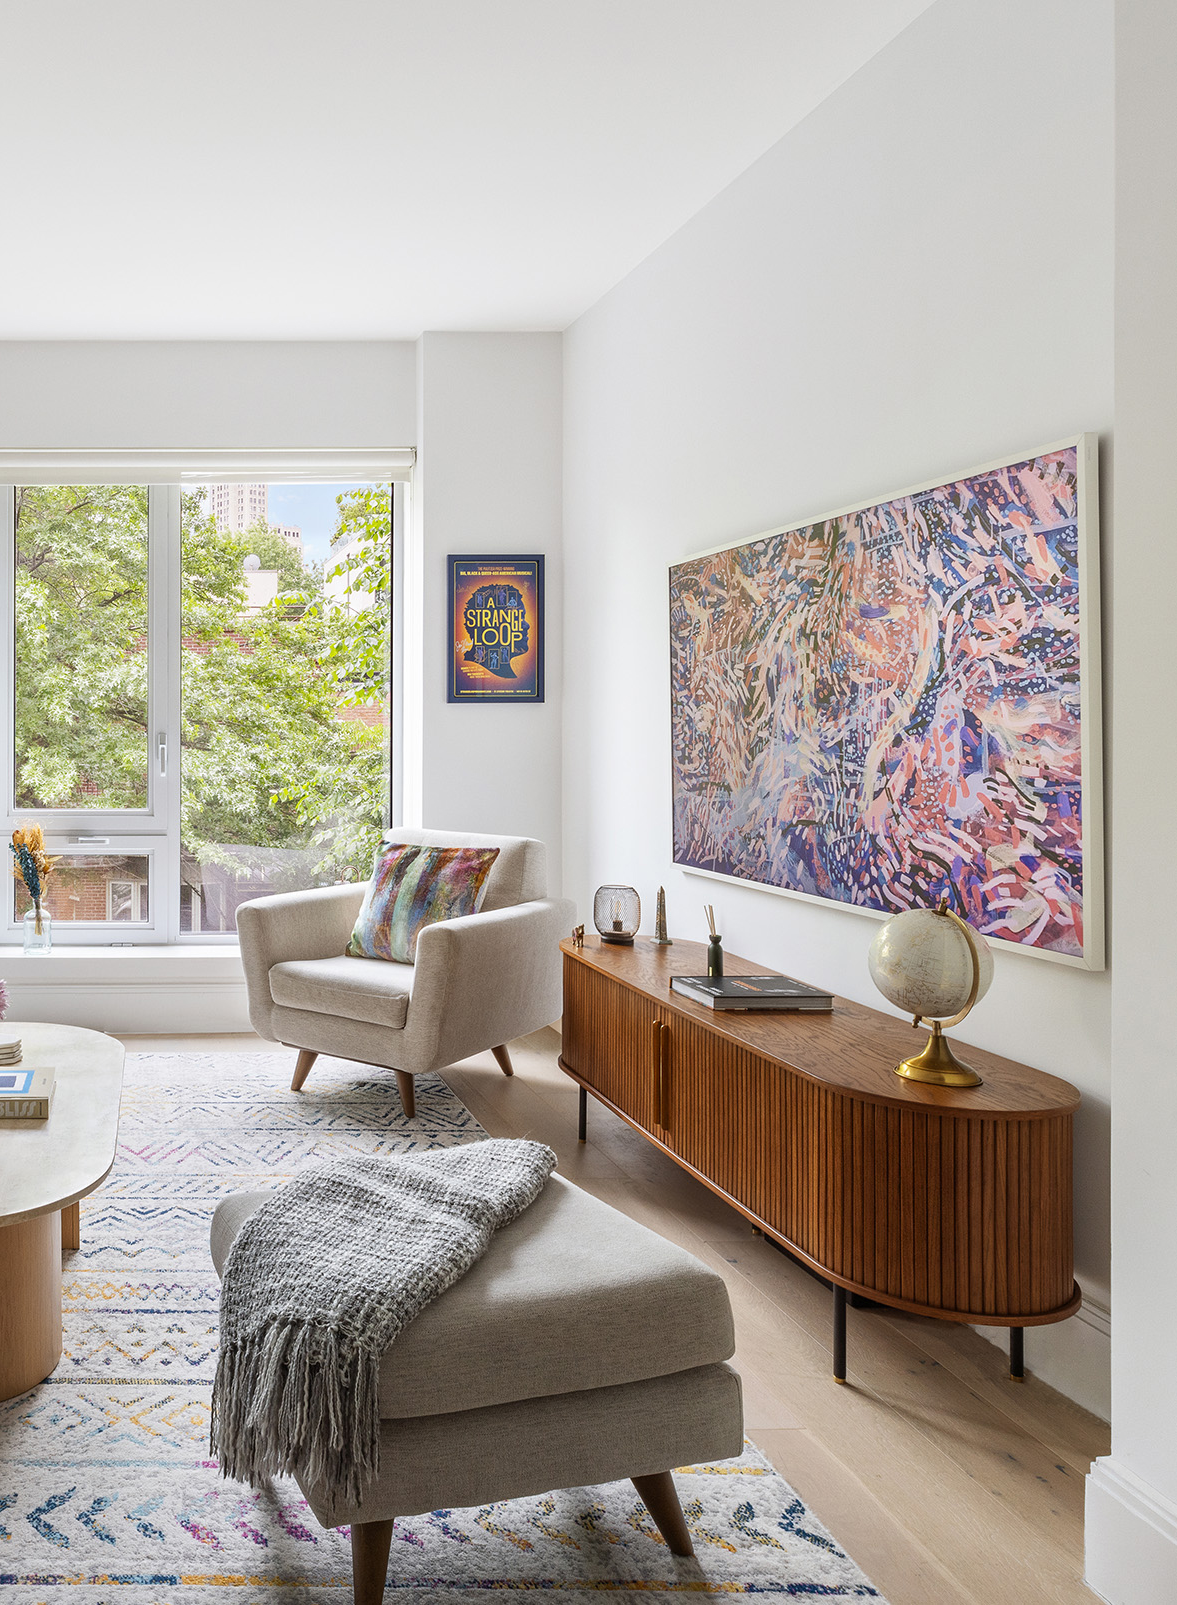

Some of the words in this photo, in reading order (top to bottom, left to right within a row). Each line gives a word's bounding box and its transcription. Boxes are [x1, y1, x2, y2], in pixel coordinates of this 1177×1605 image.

[487, 597, 495, 608] A
[466, 609, 523, 632] STRANGE
[474, 623, 523, 653] LOOP
